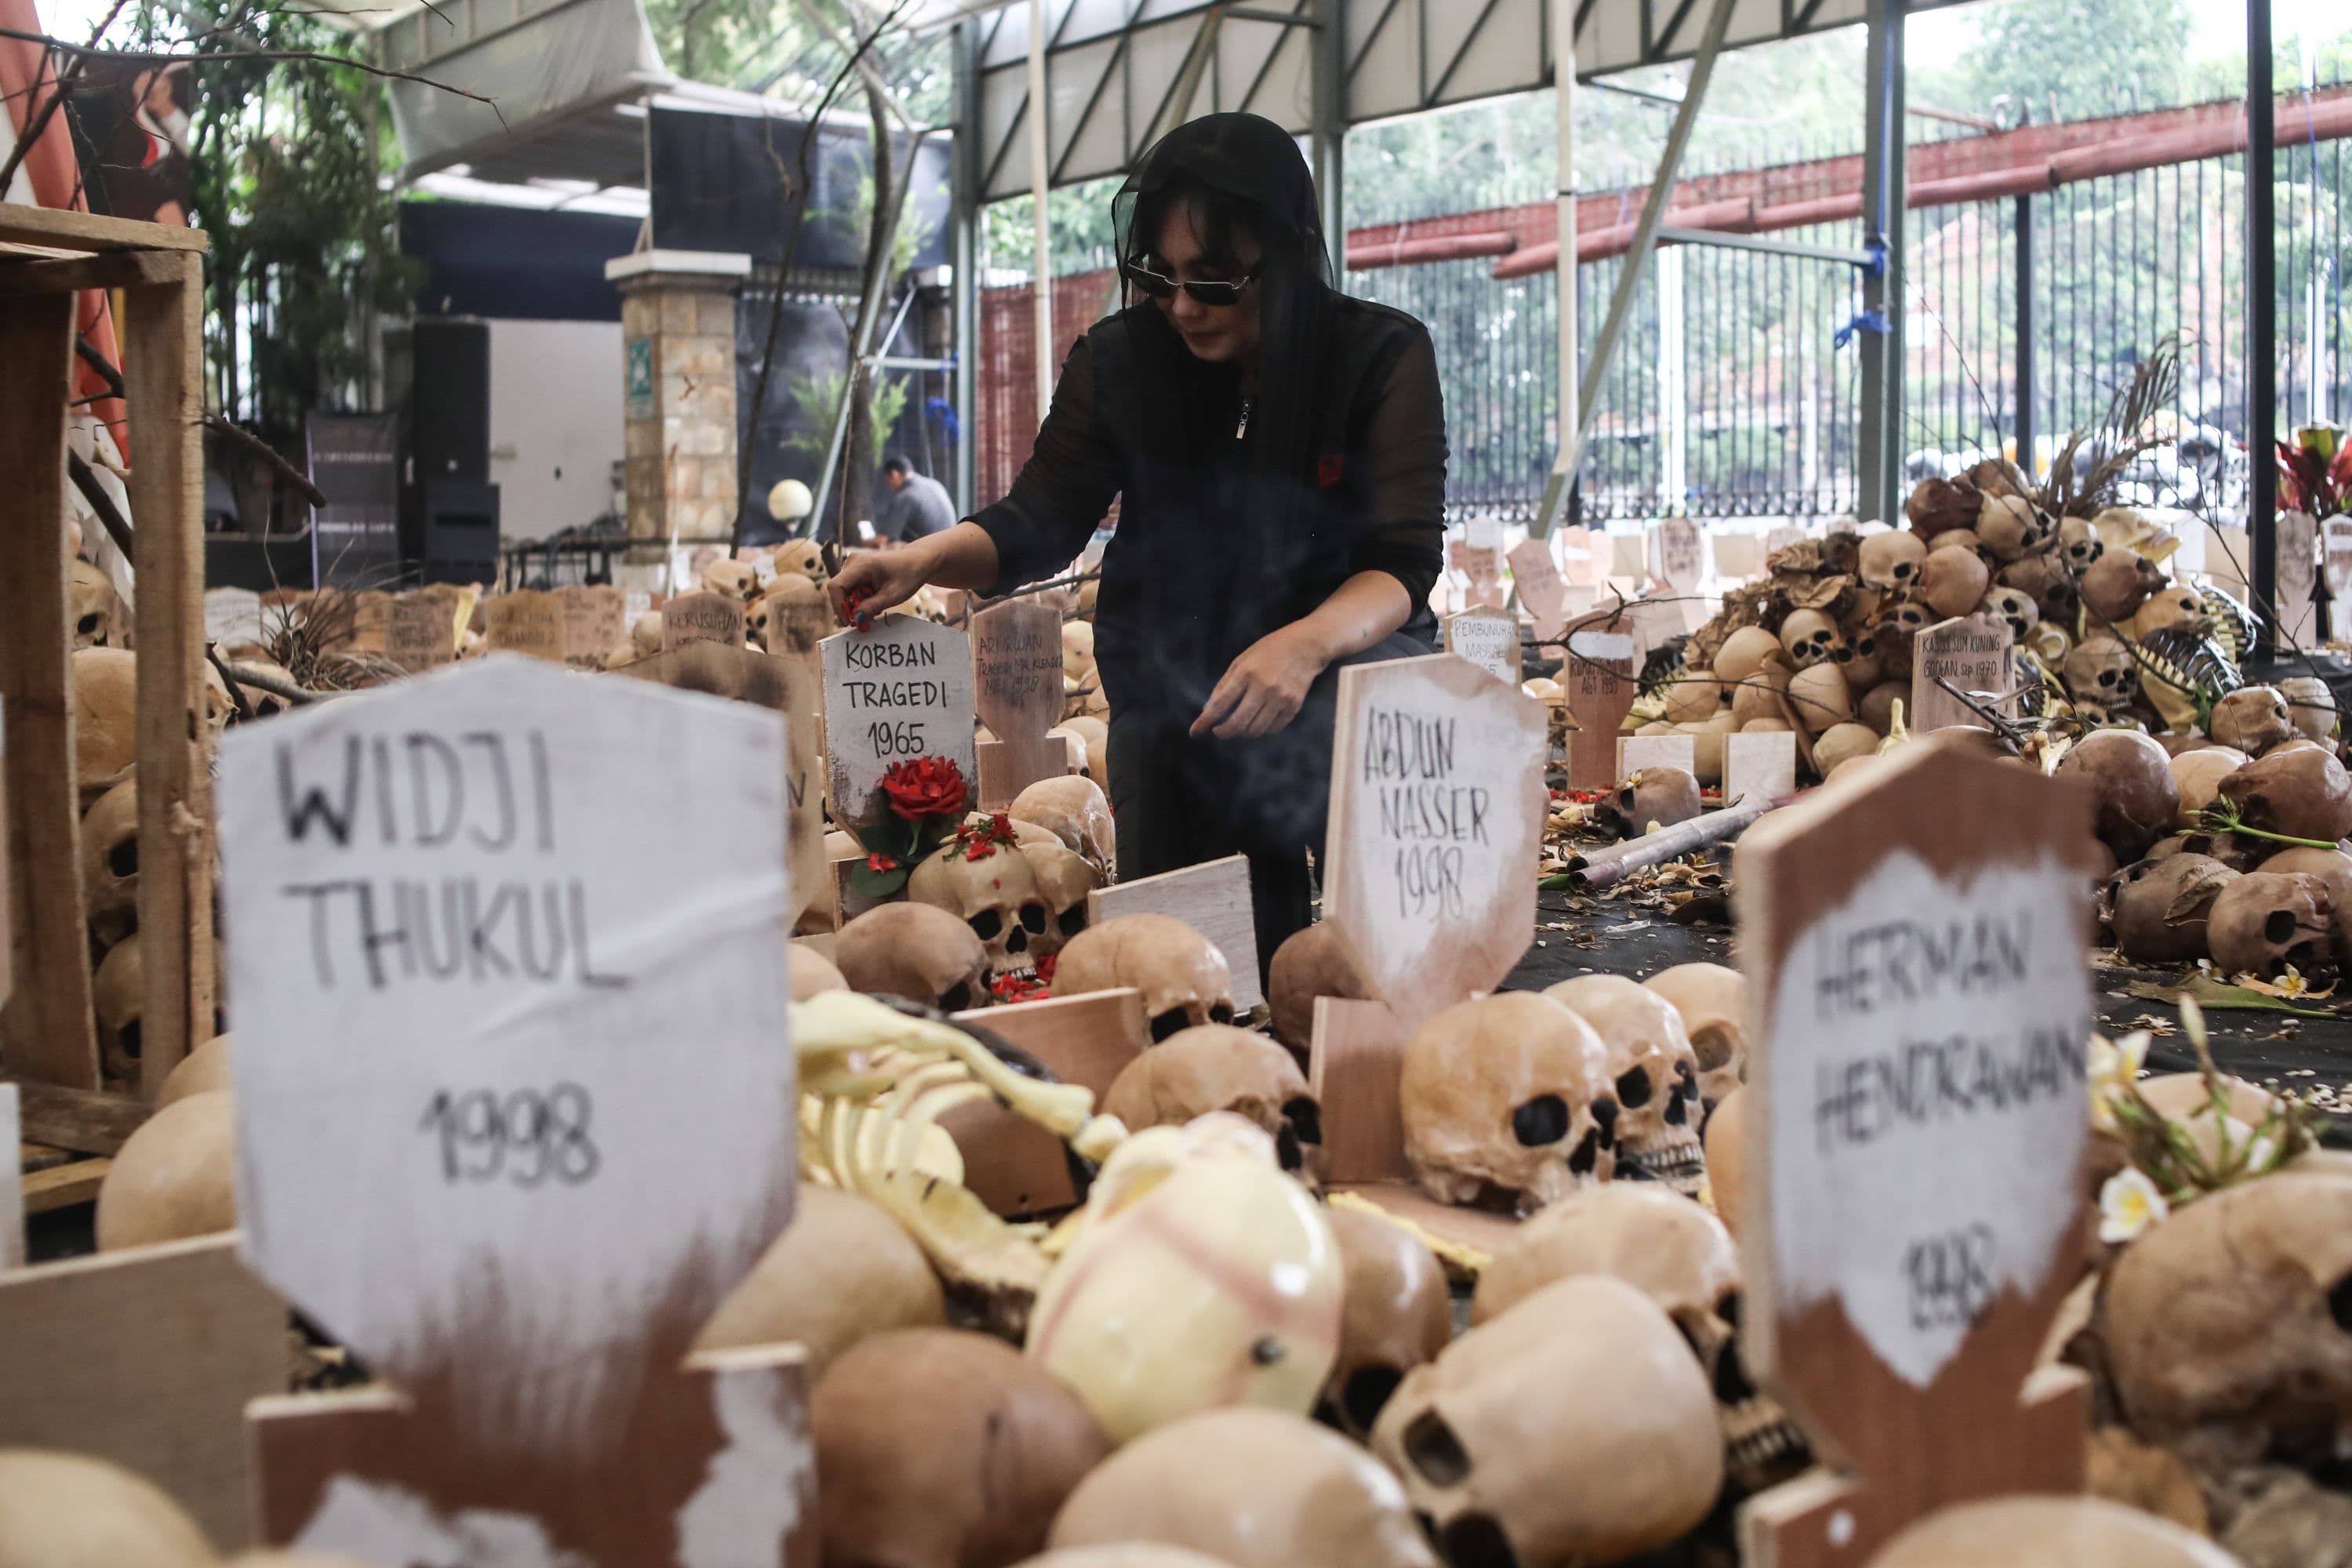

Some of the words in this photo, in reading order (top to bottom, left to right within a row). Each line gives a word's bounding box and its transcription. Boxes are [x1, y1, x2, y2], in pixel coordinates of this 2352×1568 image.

[845, 641, 936, 670] KORBAN
[1922, 636, 1951, 653] KASUS
[1969, 634, 2000, 653] KUNING
[842, 681, 947, 709] TRAGEDI
[867, 721, 925, 759] 1965
[1364, 705, 1456, 783] ABDUN
[274, 728, 556, 855] WIDJI
[1379, 786, 1490, 847] NASSER
[1394, 845, 1465, 923] 1998
[279, 877, 633, 991] THUKUL
[1815, 909, 2035, 1021] HERMAN
[1814, 1022, 2089, 1159] HENDRAWAN
[418, 1080, 603, 1191] 1998
